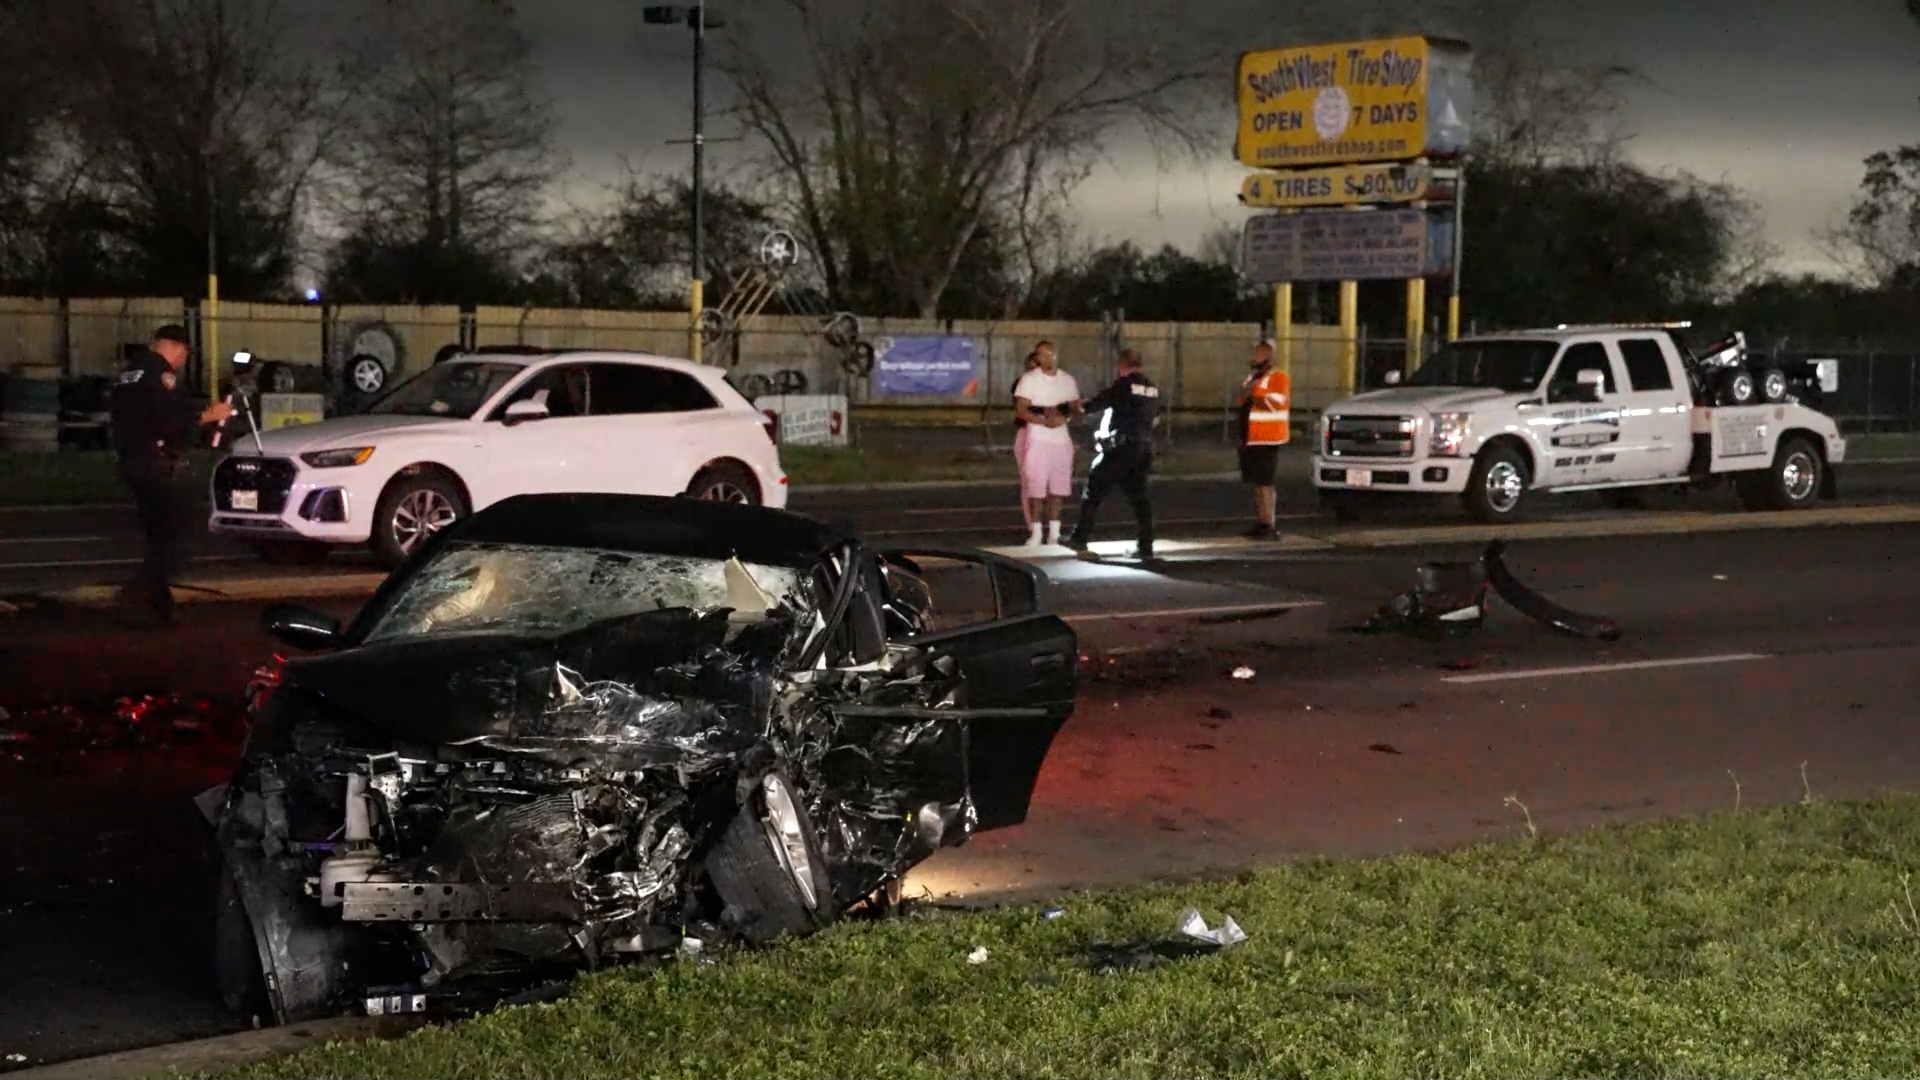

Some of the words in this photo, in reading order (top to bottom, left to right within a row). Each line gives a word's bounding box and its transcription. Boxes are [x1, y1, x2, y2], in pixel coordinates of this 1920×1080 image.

[1248, 53, 1336, 102] SouthWest
[1253, 111, 1303, 132] OPEN
[1353, 107, 1364, 126] 7
[1370, 102, 1418, 126] DAYS
[1250, 180, 1260, 199] 4
[1273, 176, 1332, 198] TIRES
